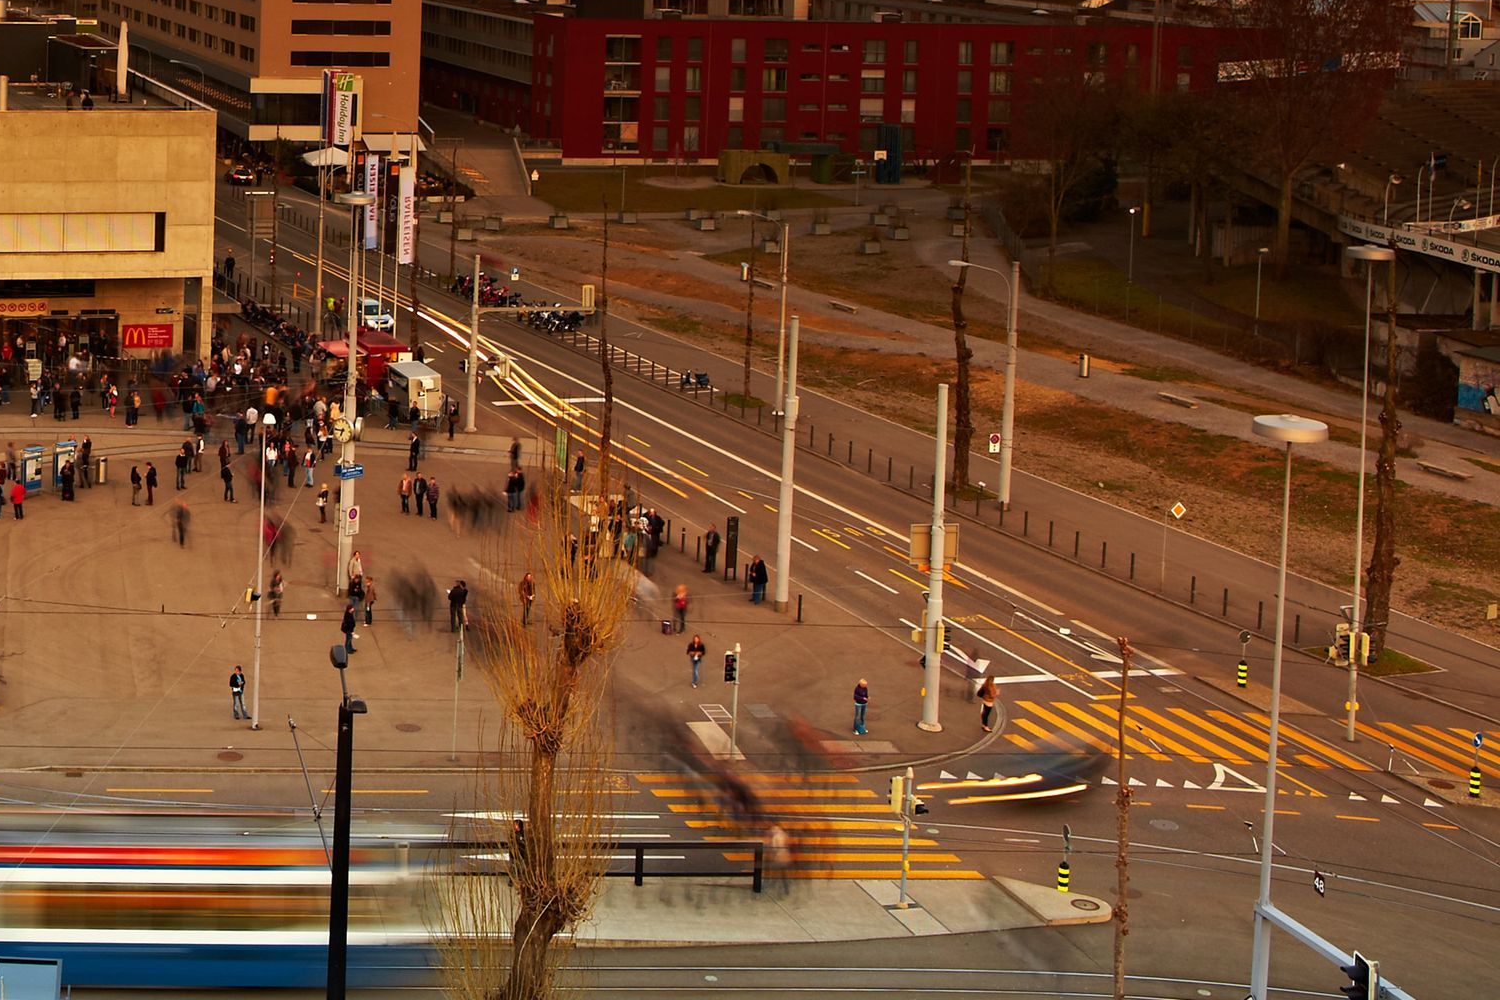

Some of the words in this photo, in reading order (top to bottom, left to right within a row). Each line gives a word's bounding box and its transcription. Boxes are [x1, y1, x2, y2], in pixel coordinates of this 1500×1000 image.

[337, 94, 349, 128] Holiday
[338, 129, 348, 143] Inn
[369, 163, 377, 221] RAIEISEN
[1429, 241, 1455, 256] ŠKODA
[1313, 877, 1325, 894] 48
